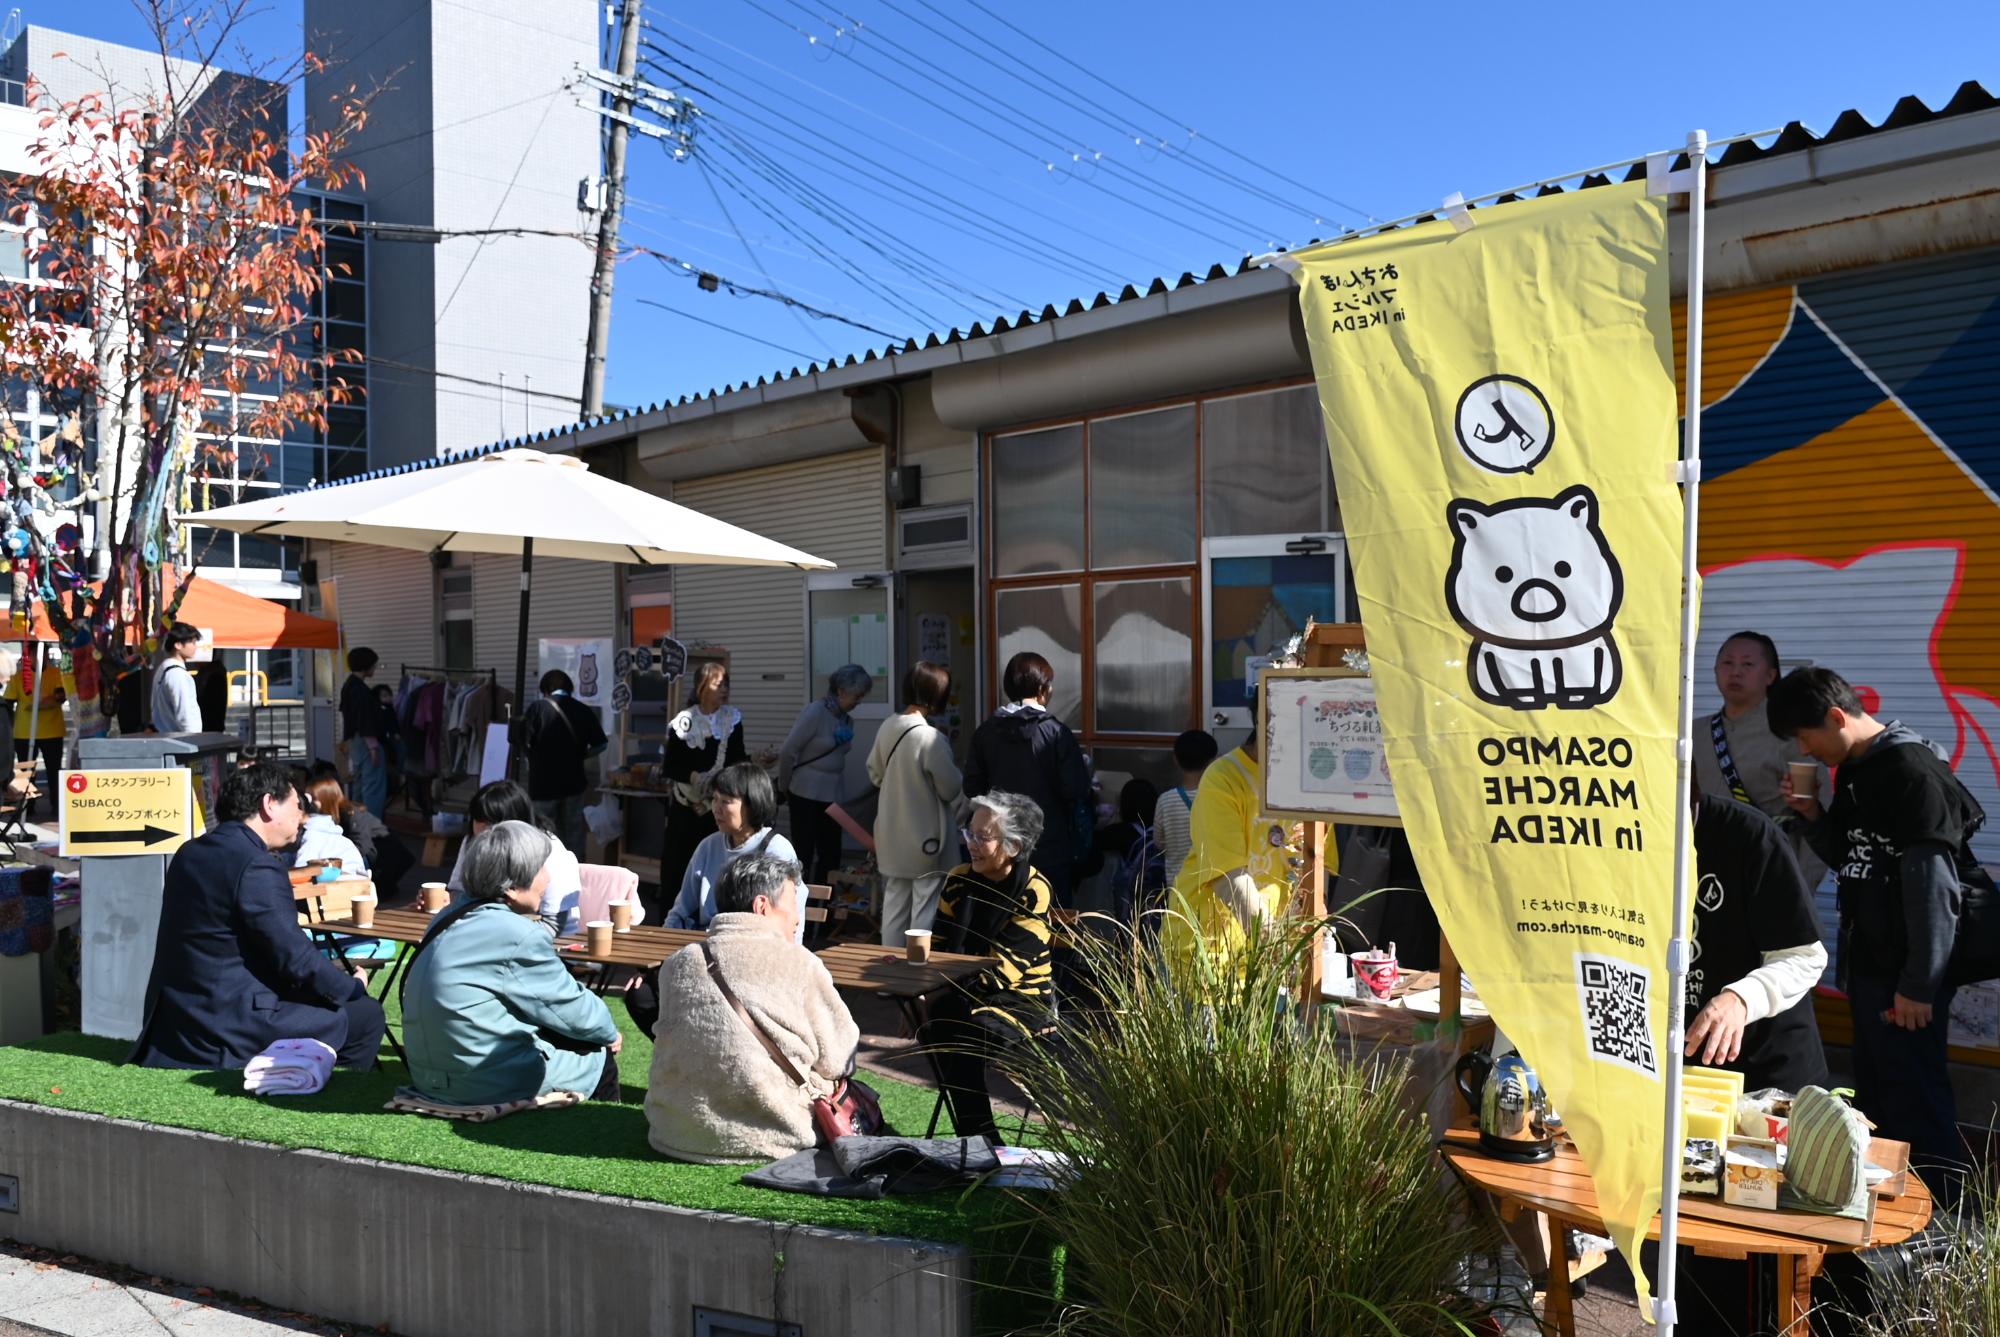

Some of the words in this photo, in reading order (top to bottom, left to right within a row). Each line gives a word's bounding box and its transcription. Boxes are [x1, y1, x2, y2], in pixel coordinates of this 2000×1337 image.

[71, 798, 122, 808] SUBACO
[105, 808, 181, 820] スタンプポイント
